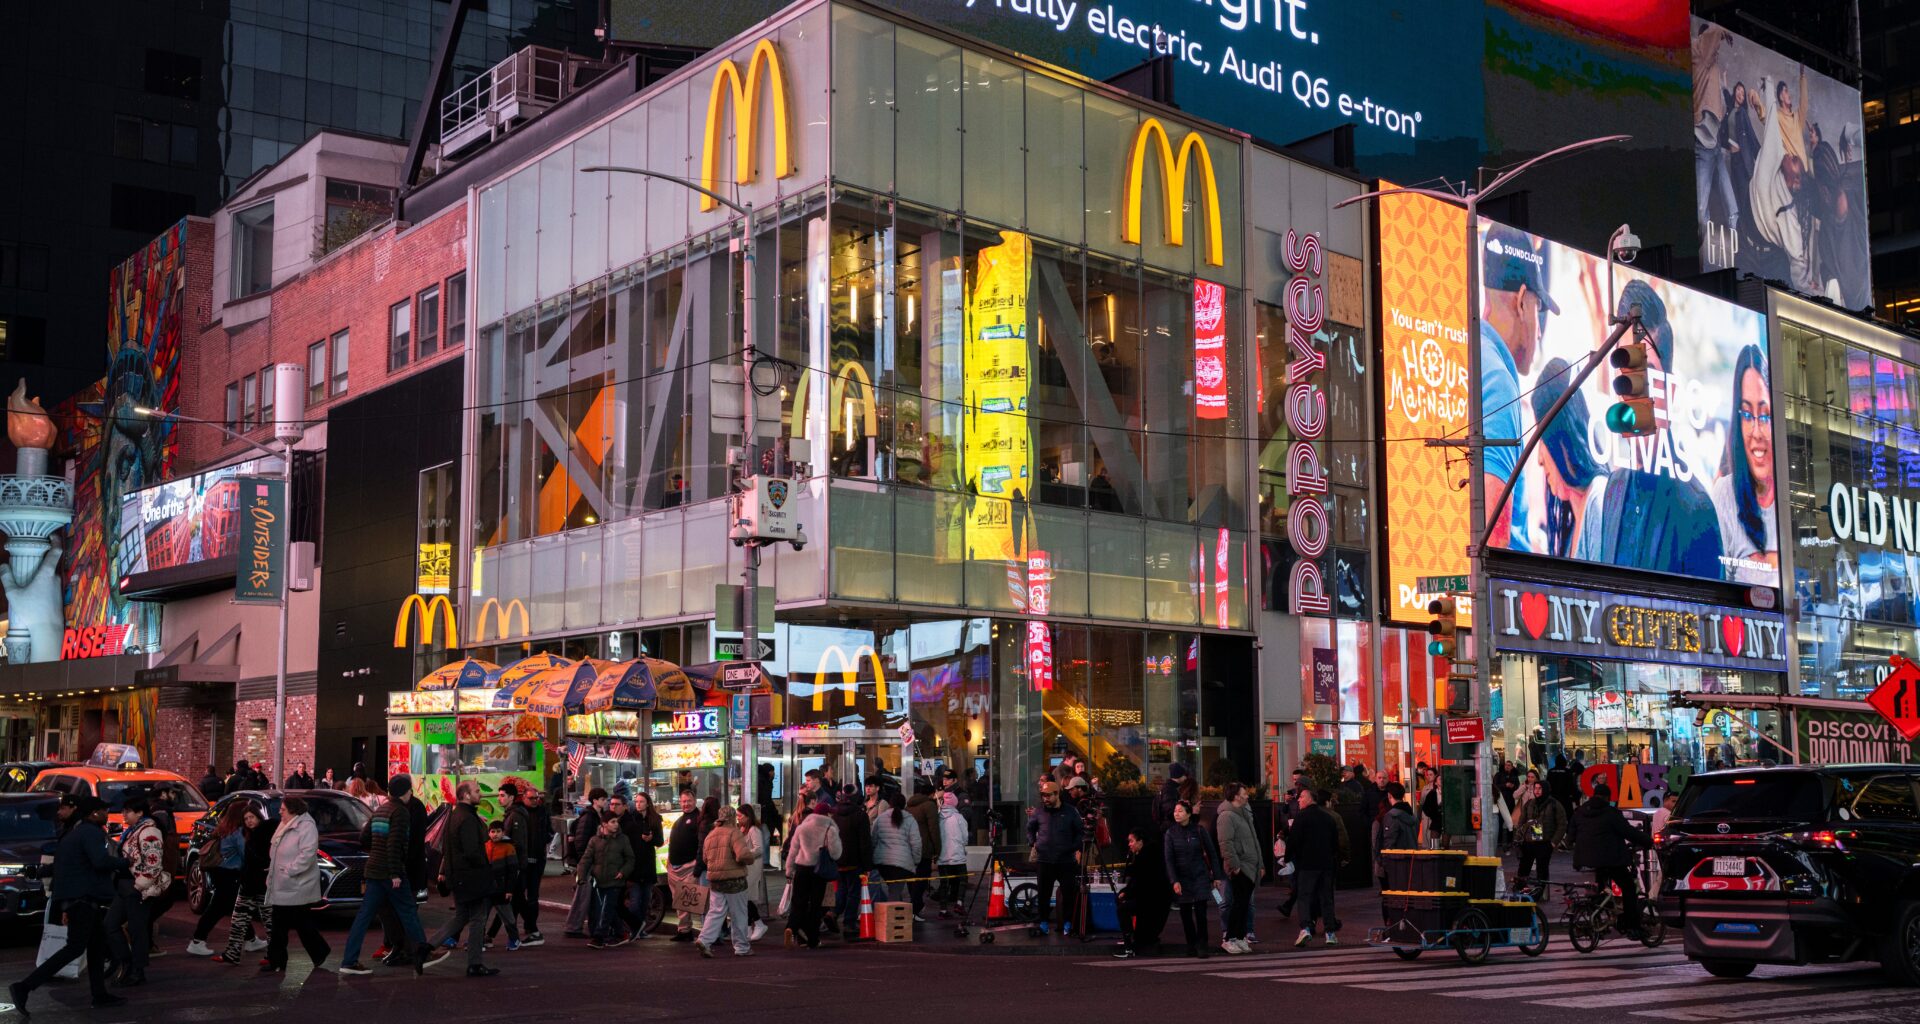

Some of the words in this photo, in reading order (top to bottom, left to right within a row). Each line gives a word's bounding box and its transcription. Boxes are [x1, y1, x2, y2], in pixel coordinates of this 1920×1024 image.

[995, 0, 1077, 31] ully
[1220, 46, 1282, 94] Audi
[1292, 70, 1331, 108] Q6
[1504, 244, 1544, 265] SOUNDCLOUD
[1706, 220, 1739, 268] GAP
[1391, 308, 1413, 330] You
[1415, 318, 1442, 338] can't
[1444, 327, 1468, 344] rush
[1587, 418, 1694, 482] OLIVAS
[1830, 482, 1887, 545] OLD
[249, 507, 275, 590] OUTSIDERS
[1430, 579, 1439, 592] W
[1443, 578, 1457, 592] 45
[723, 644, 741, 654] ONE
[1610, 605, 1700, 653] GIFTS
[726, 670, 738, 680] ONE
[743, 668, 757, 678] WAY
[1316, 661, 1334, 673] Open
